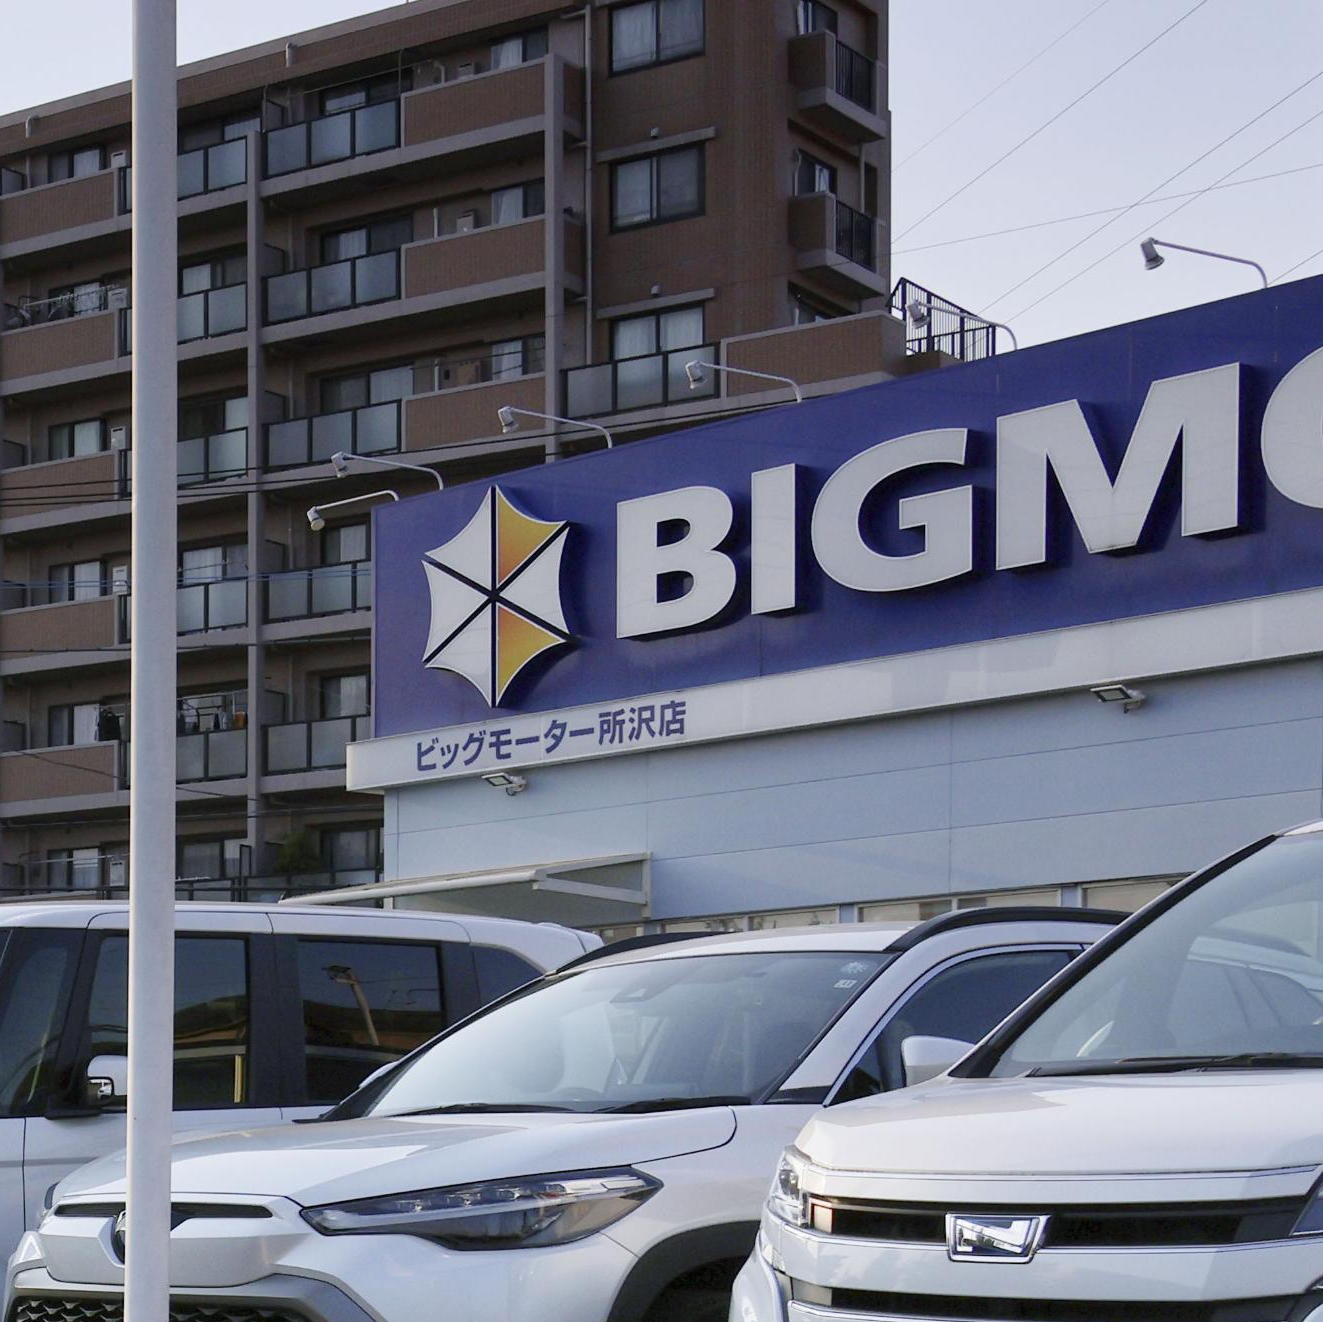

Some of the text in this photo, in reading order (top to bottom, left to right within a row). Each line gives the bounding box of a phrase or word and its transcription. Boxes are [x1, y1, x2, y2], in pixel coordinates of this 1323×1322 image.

[416, 700, 687, 772] ビッグモーター所沢店
